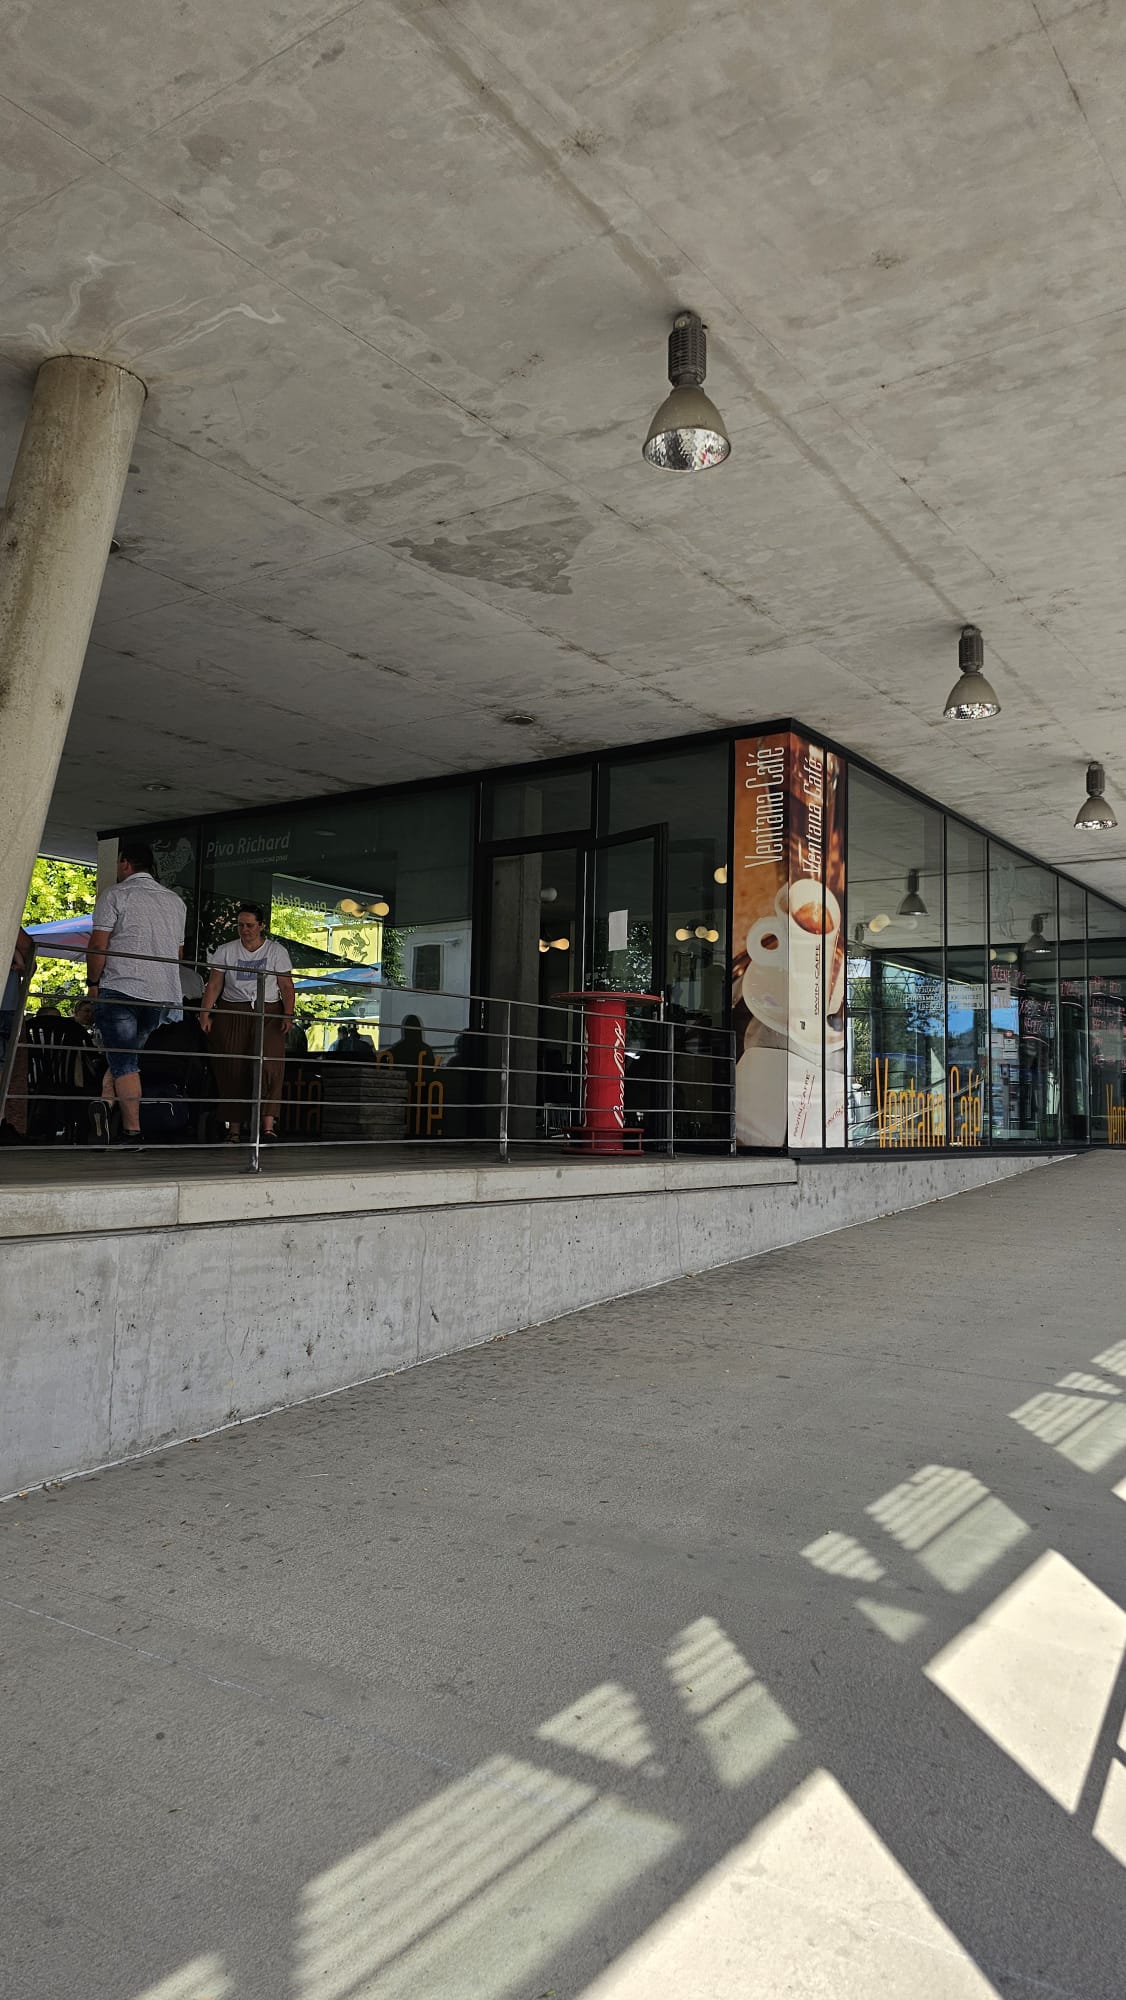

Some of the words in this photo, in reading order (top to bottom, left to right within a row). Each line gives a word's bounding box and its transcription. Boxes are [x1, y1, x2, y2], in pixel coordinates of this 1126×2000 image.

[745, 746, 785, 790] Café
[803, 757, 823, 797] Café
[205, 840, 234, 859] Pivo
[237, 831, 291, 855] Richard
[744, 791, 784, 869] Ventana
[802, 801, 823, 875] Ventana
[875, 1056, 945, 1149] Ventana
[950, 1065, 982, 1148] Café
[1105, 1083, 1126, 1146] Vent
